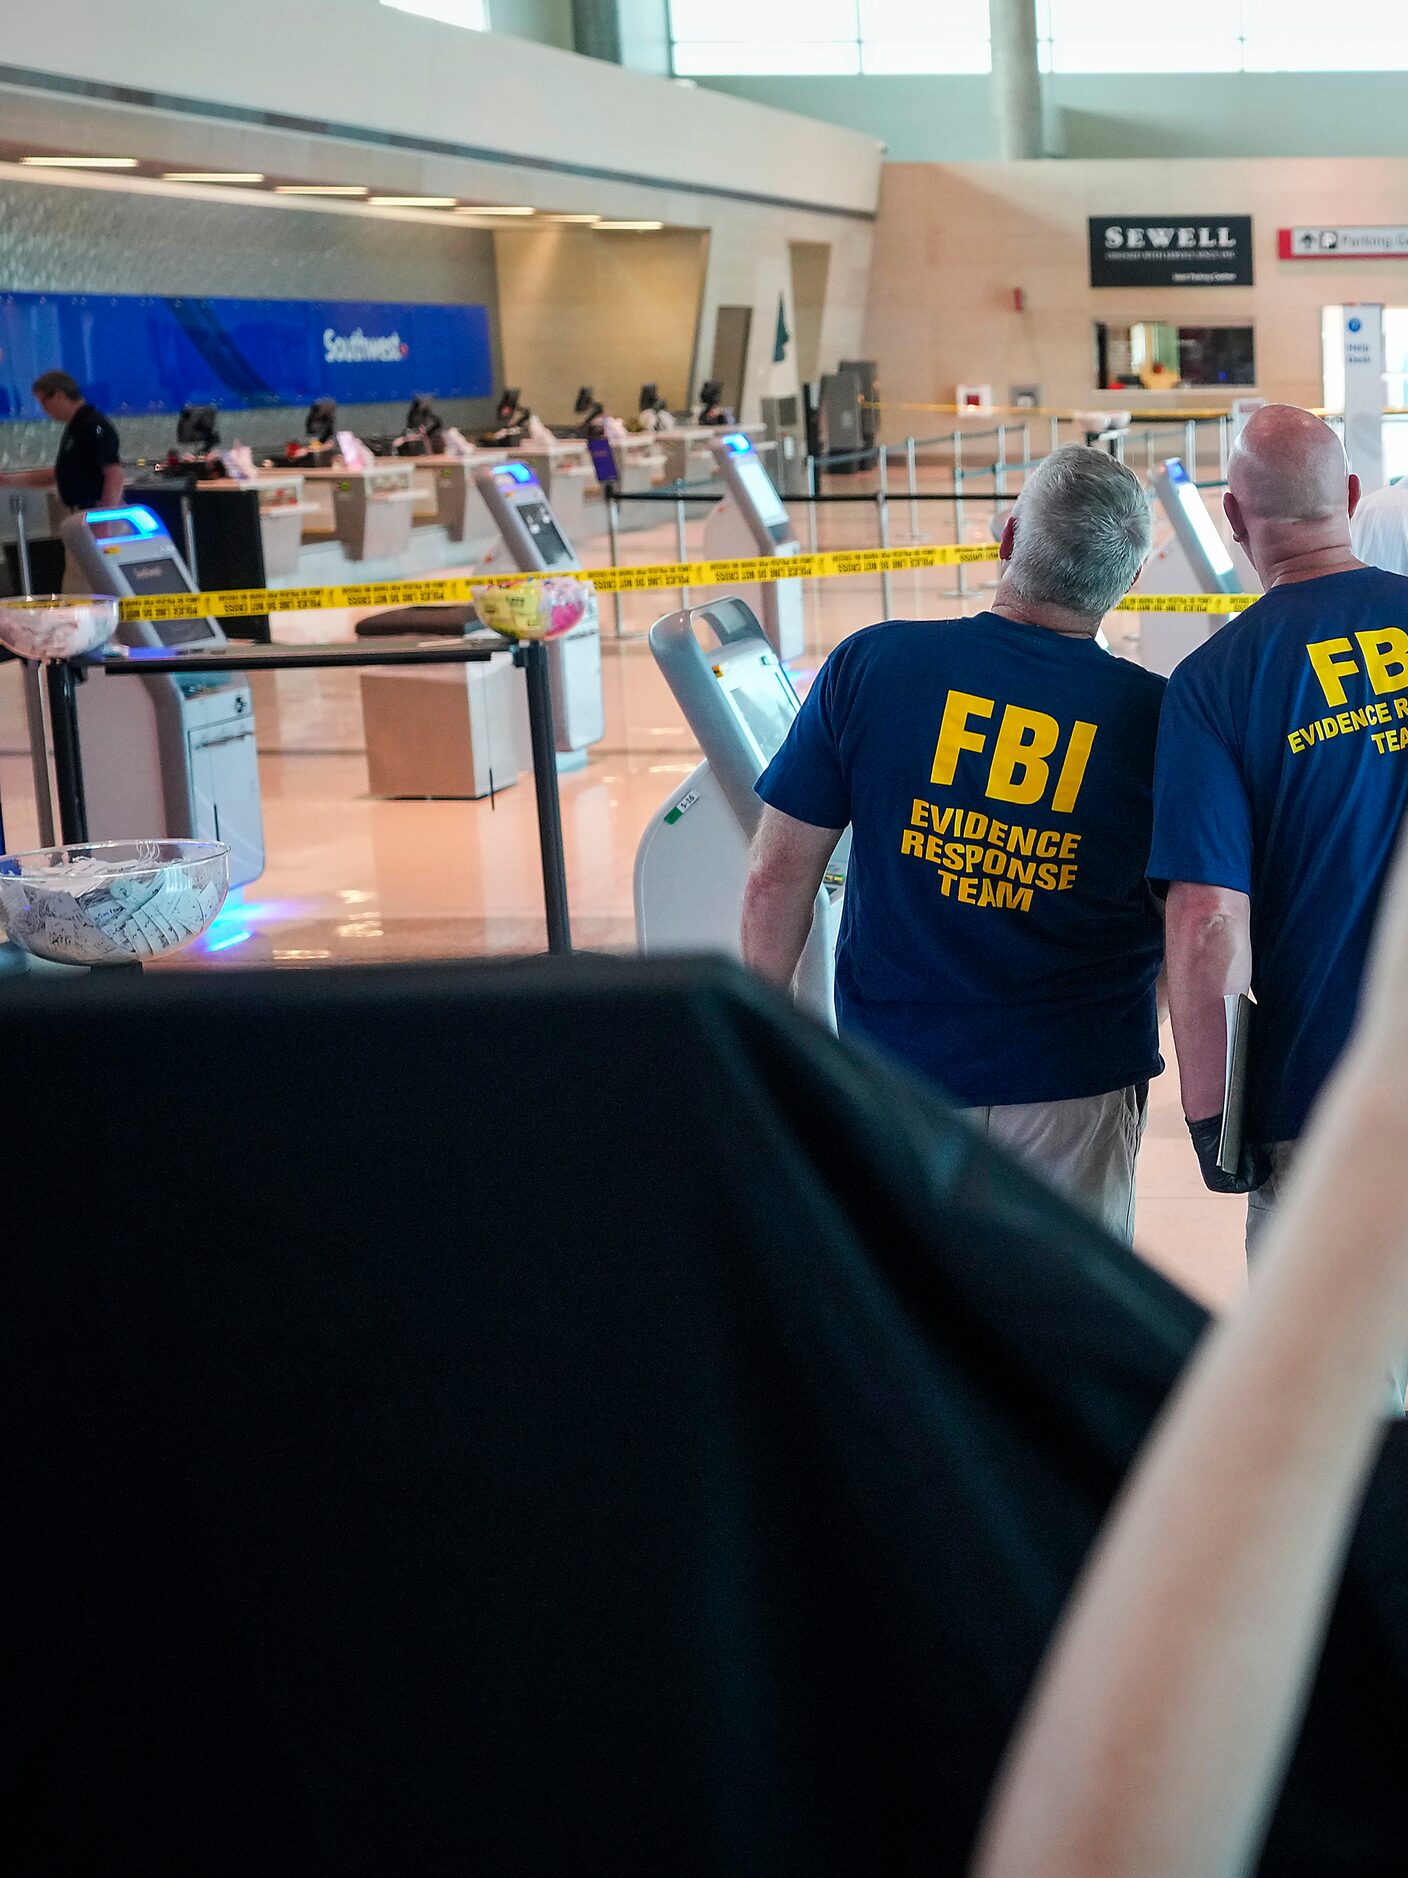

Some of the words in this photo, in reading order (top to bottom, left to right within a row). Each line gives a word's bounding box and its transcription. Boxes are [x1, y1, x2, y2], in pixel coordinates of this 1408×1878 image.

[1105, 226, 1236, 249] SEWELL
[1343, 235, 1391, 247] Parking
[930, 689, 1098, 813] FBI
[1287, 703, 1392, 754] EVIDENCE
[911, 798, 1082, 859] EVIDENCE
[901, 829, 1078, 891] RESPONSE
[938, 869, 1034, 912] TEAM
